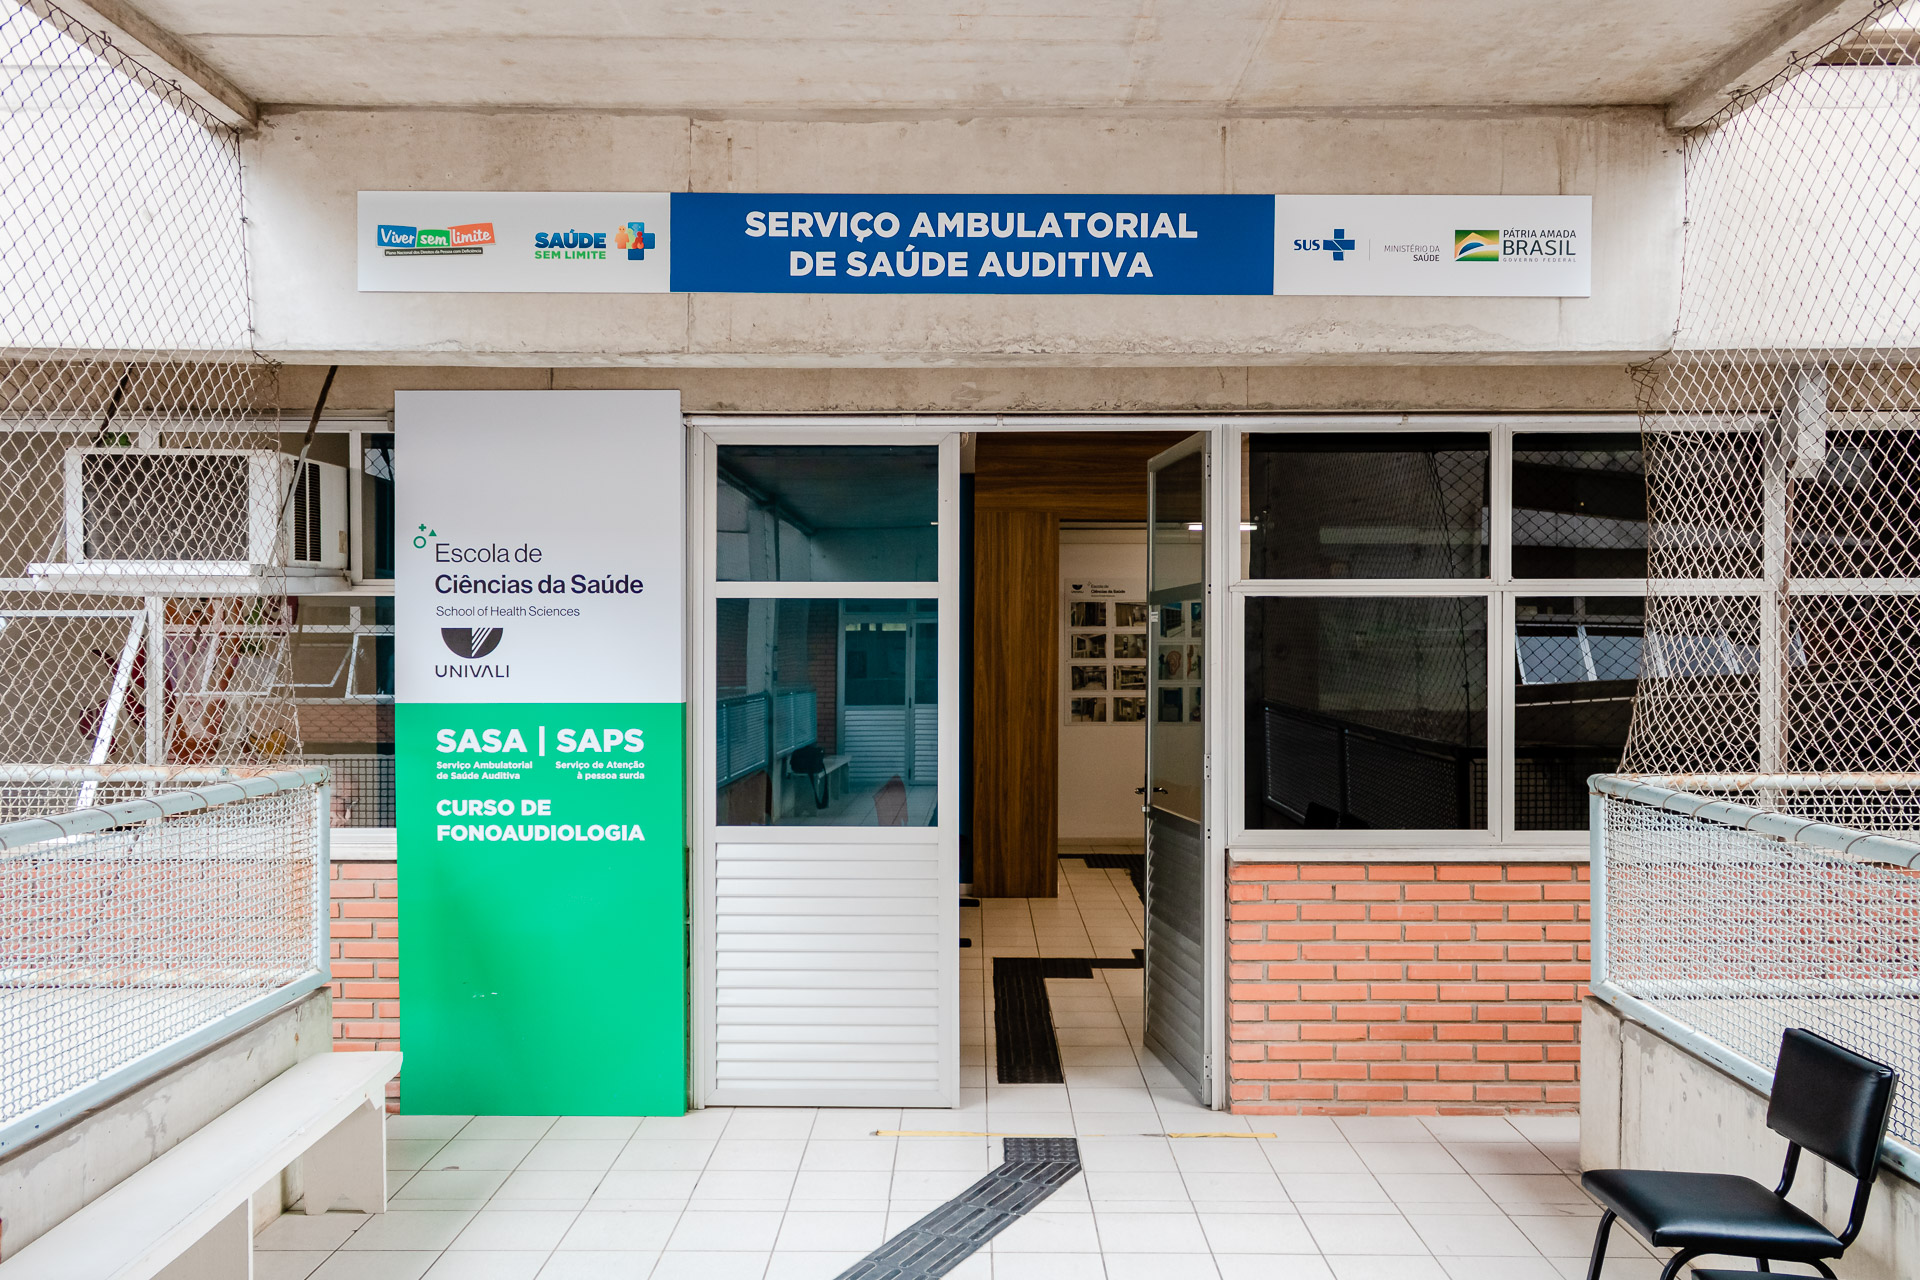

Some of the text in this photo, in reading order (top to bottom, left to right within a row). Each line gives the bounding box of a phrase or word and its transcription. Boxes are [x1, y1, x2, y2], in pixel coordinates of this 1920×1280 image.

[745, 211, 1197, 243] SERVIÇO AMBULATORIAL
[1504, 228, 1576, 238] PÁTRIA AMADA
[381, 227, 492, 245] Viver sem limite
[535, 229, 606, 248] SAÚDE
[1294, 240, 1320, 250] SUS
[1384, 244, 1428, 252] MINISTÉRIO
[1503, 240, 1576, 255] BRASIL
[535, 251, 606, 259] SEM LIMITE
[790, 244, 1153, 277] DE SAÚDE AUDITIVA
[1414, 253, 1439, 261] SAÚDE
[436, 544, 542, 562] Escola de
[436, 574, 643, 594] Ciências da Saúde
[436, 606, 580, 616] School of Health Sciences
[436, 665, 509, 677] UNIVALI
[436, 728, 644, 753] SASA SAPS
[437, 761, 532, 770] Serviço Ambulatorial
[556, 761, 590, 770] Serviço
[606, 761, 644, 770] Atenção
[577, 771, 582, 779] à
[619, 771, 644, 779] surda
[436, 799, 551, 816] CURSO DE
[437, 824, 645, 841] FONOAUDIOLOGIA
